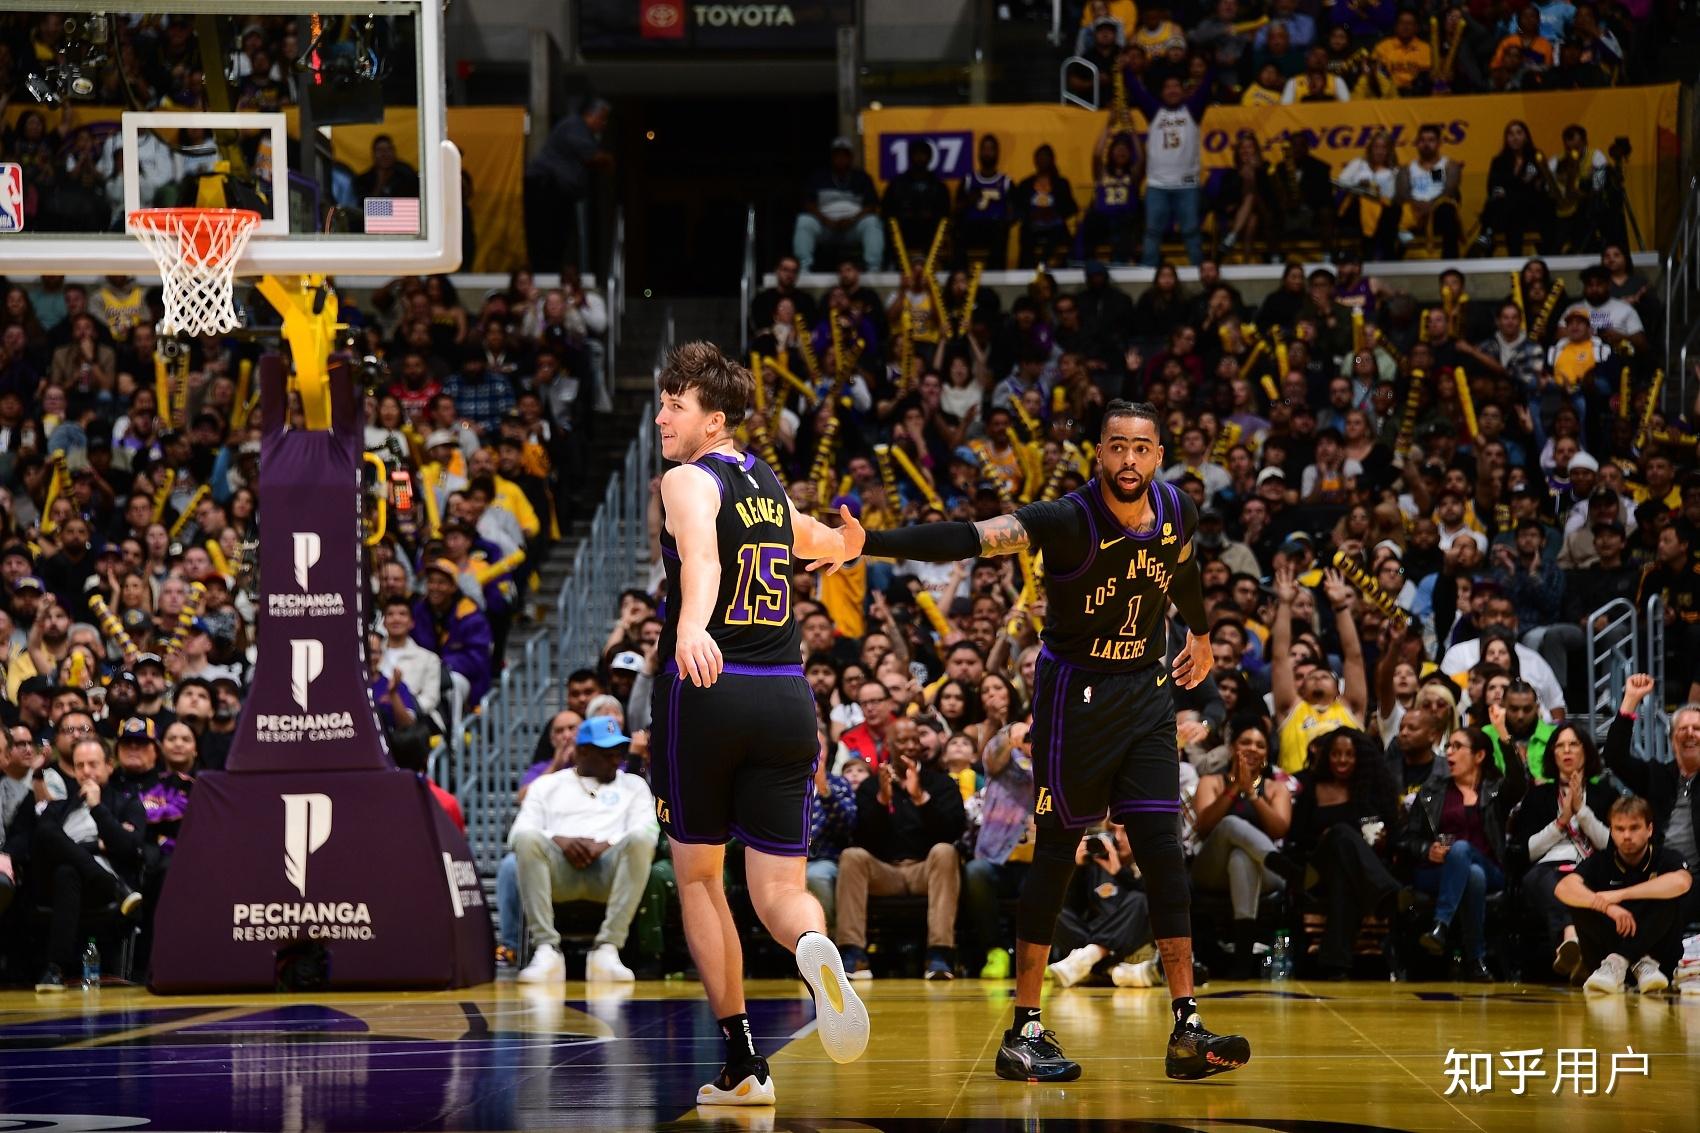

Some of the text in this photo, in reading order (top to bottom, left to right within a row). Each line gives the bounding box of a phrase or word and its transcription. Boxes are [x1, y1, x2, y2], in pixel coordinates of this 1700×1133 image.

[692, 4, 795, 26] TOYOTA
[725, 542, 790, 626] 15
[268, 593, 343, 608] PECHANGA
[1085, 577, 1117, 614] LOS
[269, 606, 305, 617] RESORT
[1119, 595, 1142, 636] 1
[1090, 638, 1147, 660] LAKERS
[256, 712, 354, 731] PECHANGA
[257, 727, 354, 743] RESORT CASINO
[1036, 786, 1053, 815] LA
[233, 902, 372, 925] PECHANGA
[232, 925, 373, 941] RESORT CASINO
